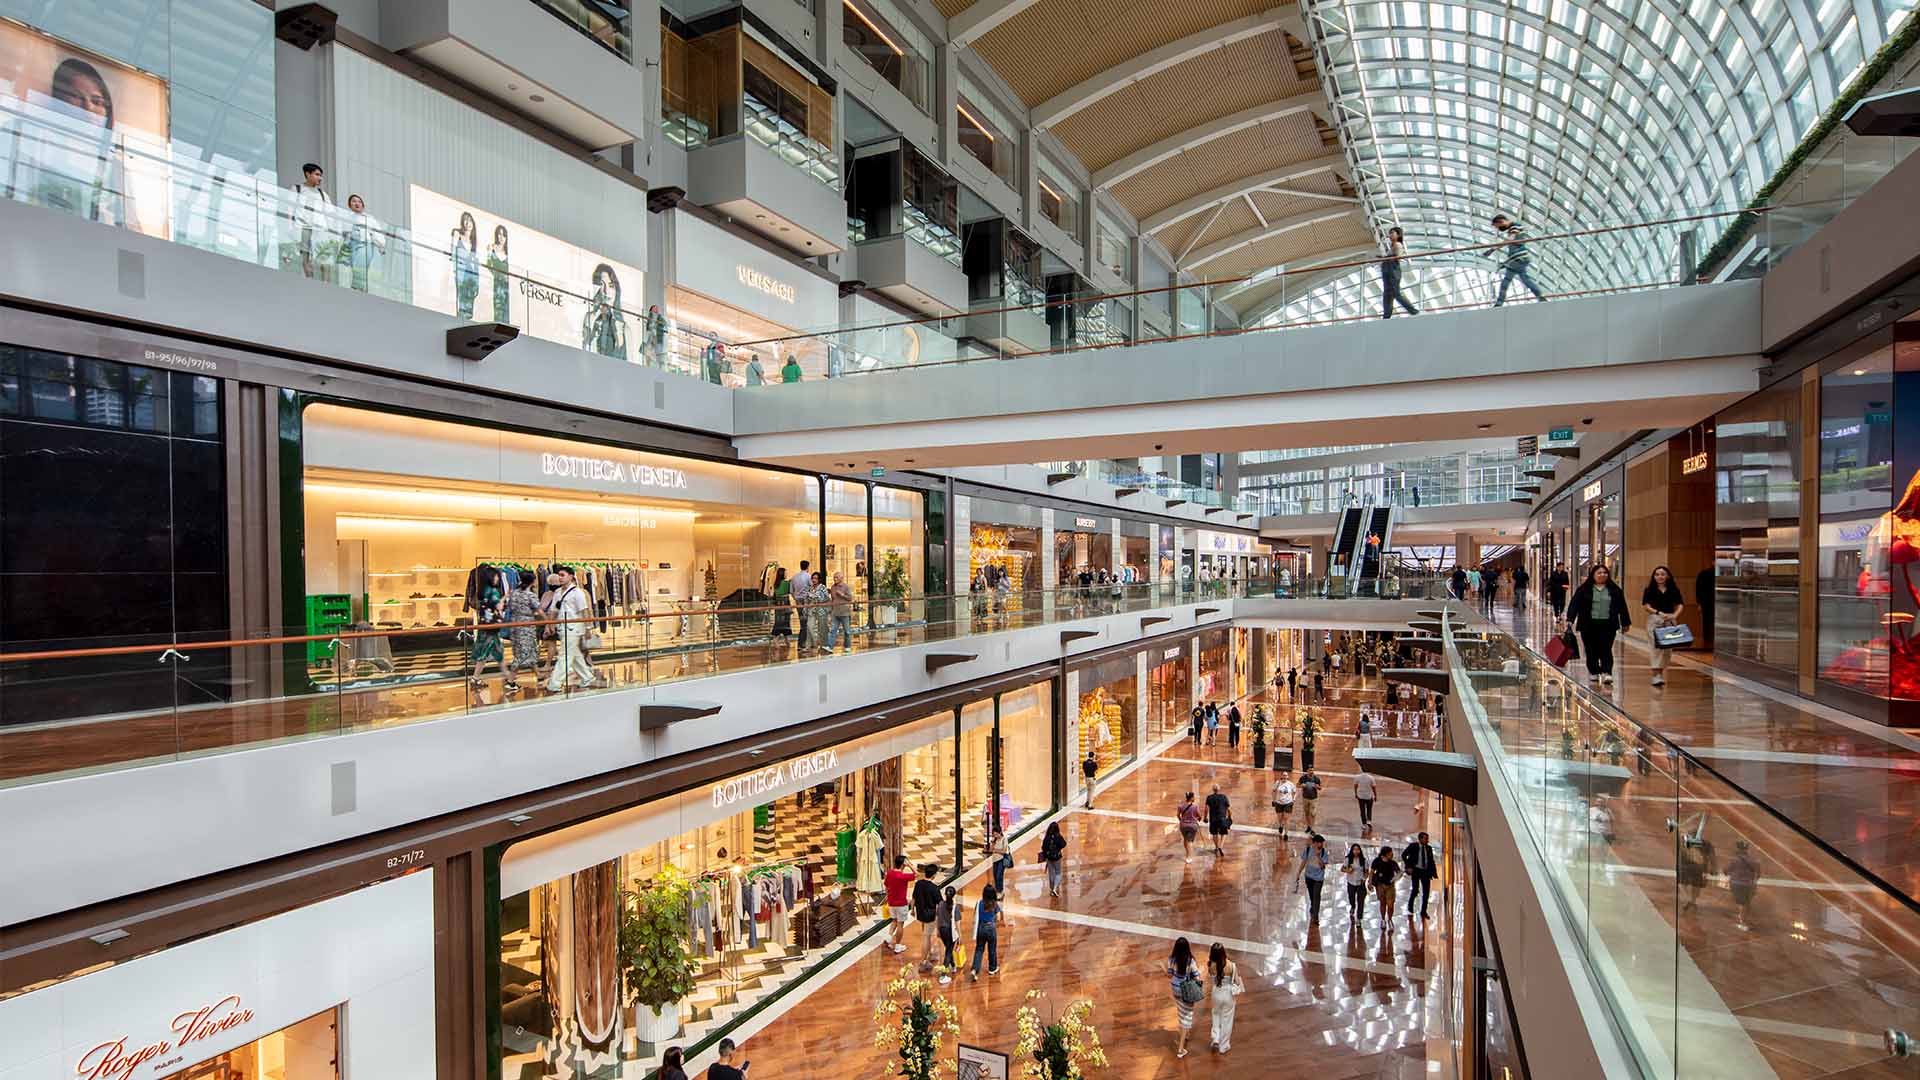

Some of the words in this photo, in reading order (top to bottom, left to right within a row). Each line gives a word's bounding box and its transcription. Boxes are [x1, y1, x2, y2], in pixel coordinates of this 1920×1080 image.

[520, 280, 563, 307] VERSACE
[736, 265, 796, 304] VERSACE
[145, 350, 217, 370] B1-95/96/97/98
[1552, 431, 1569, 440] EXIT
[542, 453, 625, 482] BOTTEGA
[631, 464, 687, 488] VENETA
[713, 766, 785, 808] BOTTEGA
[789, 749, 839, 781] VENETA
[387, 850, 425, 868] B2-71/72
[77, 1034, 171, 1080] Roger
[169, 994, 254, 1048] Vivier
[153, 1055, 184, 1072] PARIS
